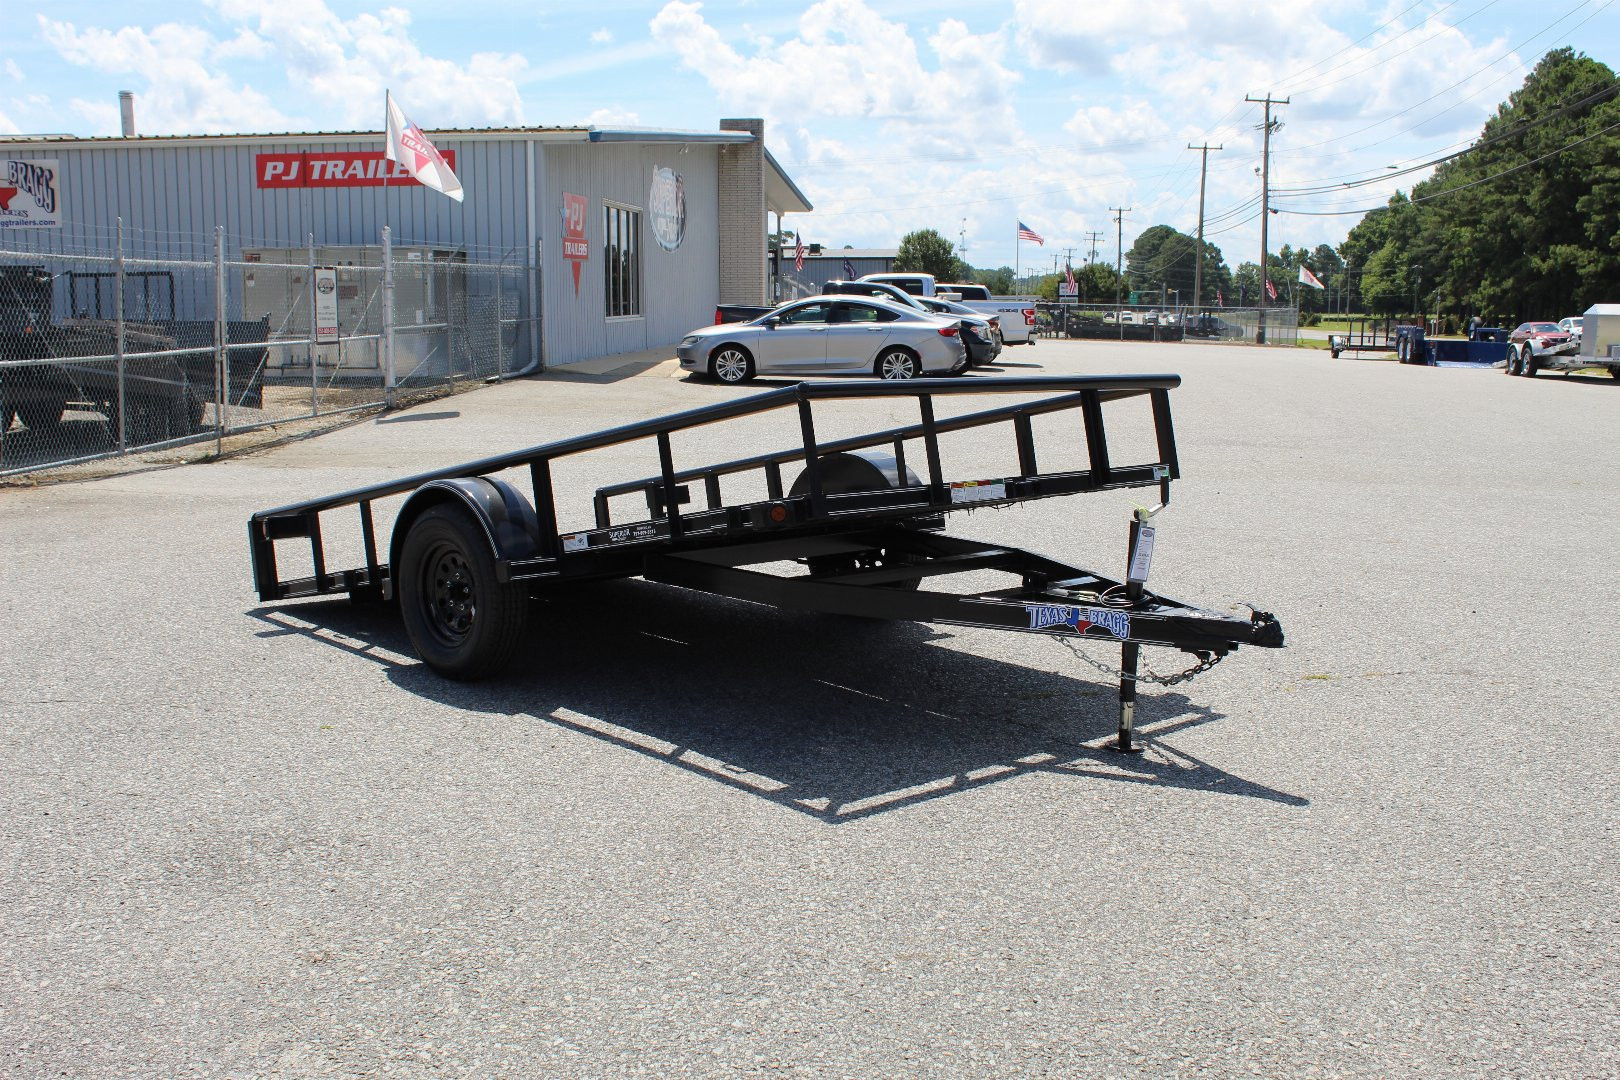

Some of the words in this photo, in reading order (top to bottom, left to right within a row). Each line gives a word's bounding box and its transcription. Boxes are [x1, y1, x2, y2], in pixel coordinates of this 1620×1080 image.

[264, 162, 299, 181] PJ
[8, 161, 55, 213] BRAGG
[570, 201, 584, 231] PJ
[564, 242, 588, 256] TRAILERS
[1026, 606, 1068, 630] TEXAS
[1089, 610, 1131, 640] BRAGG
